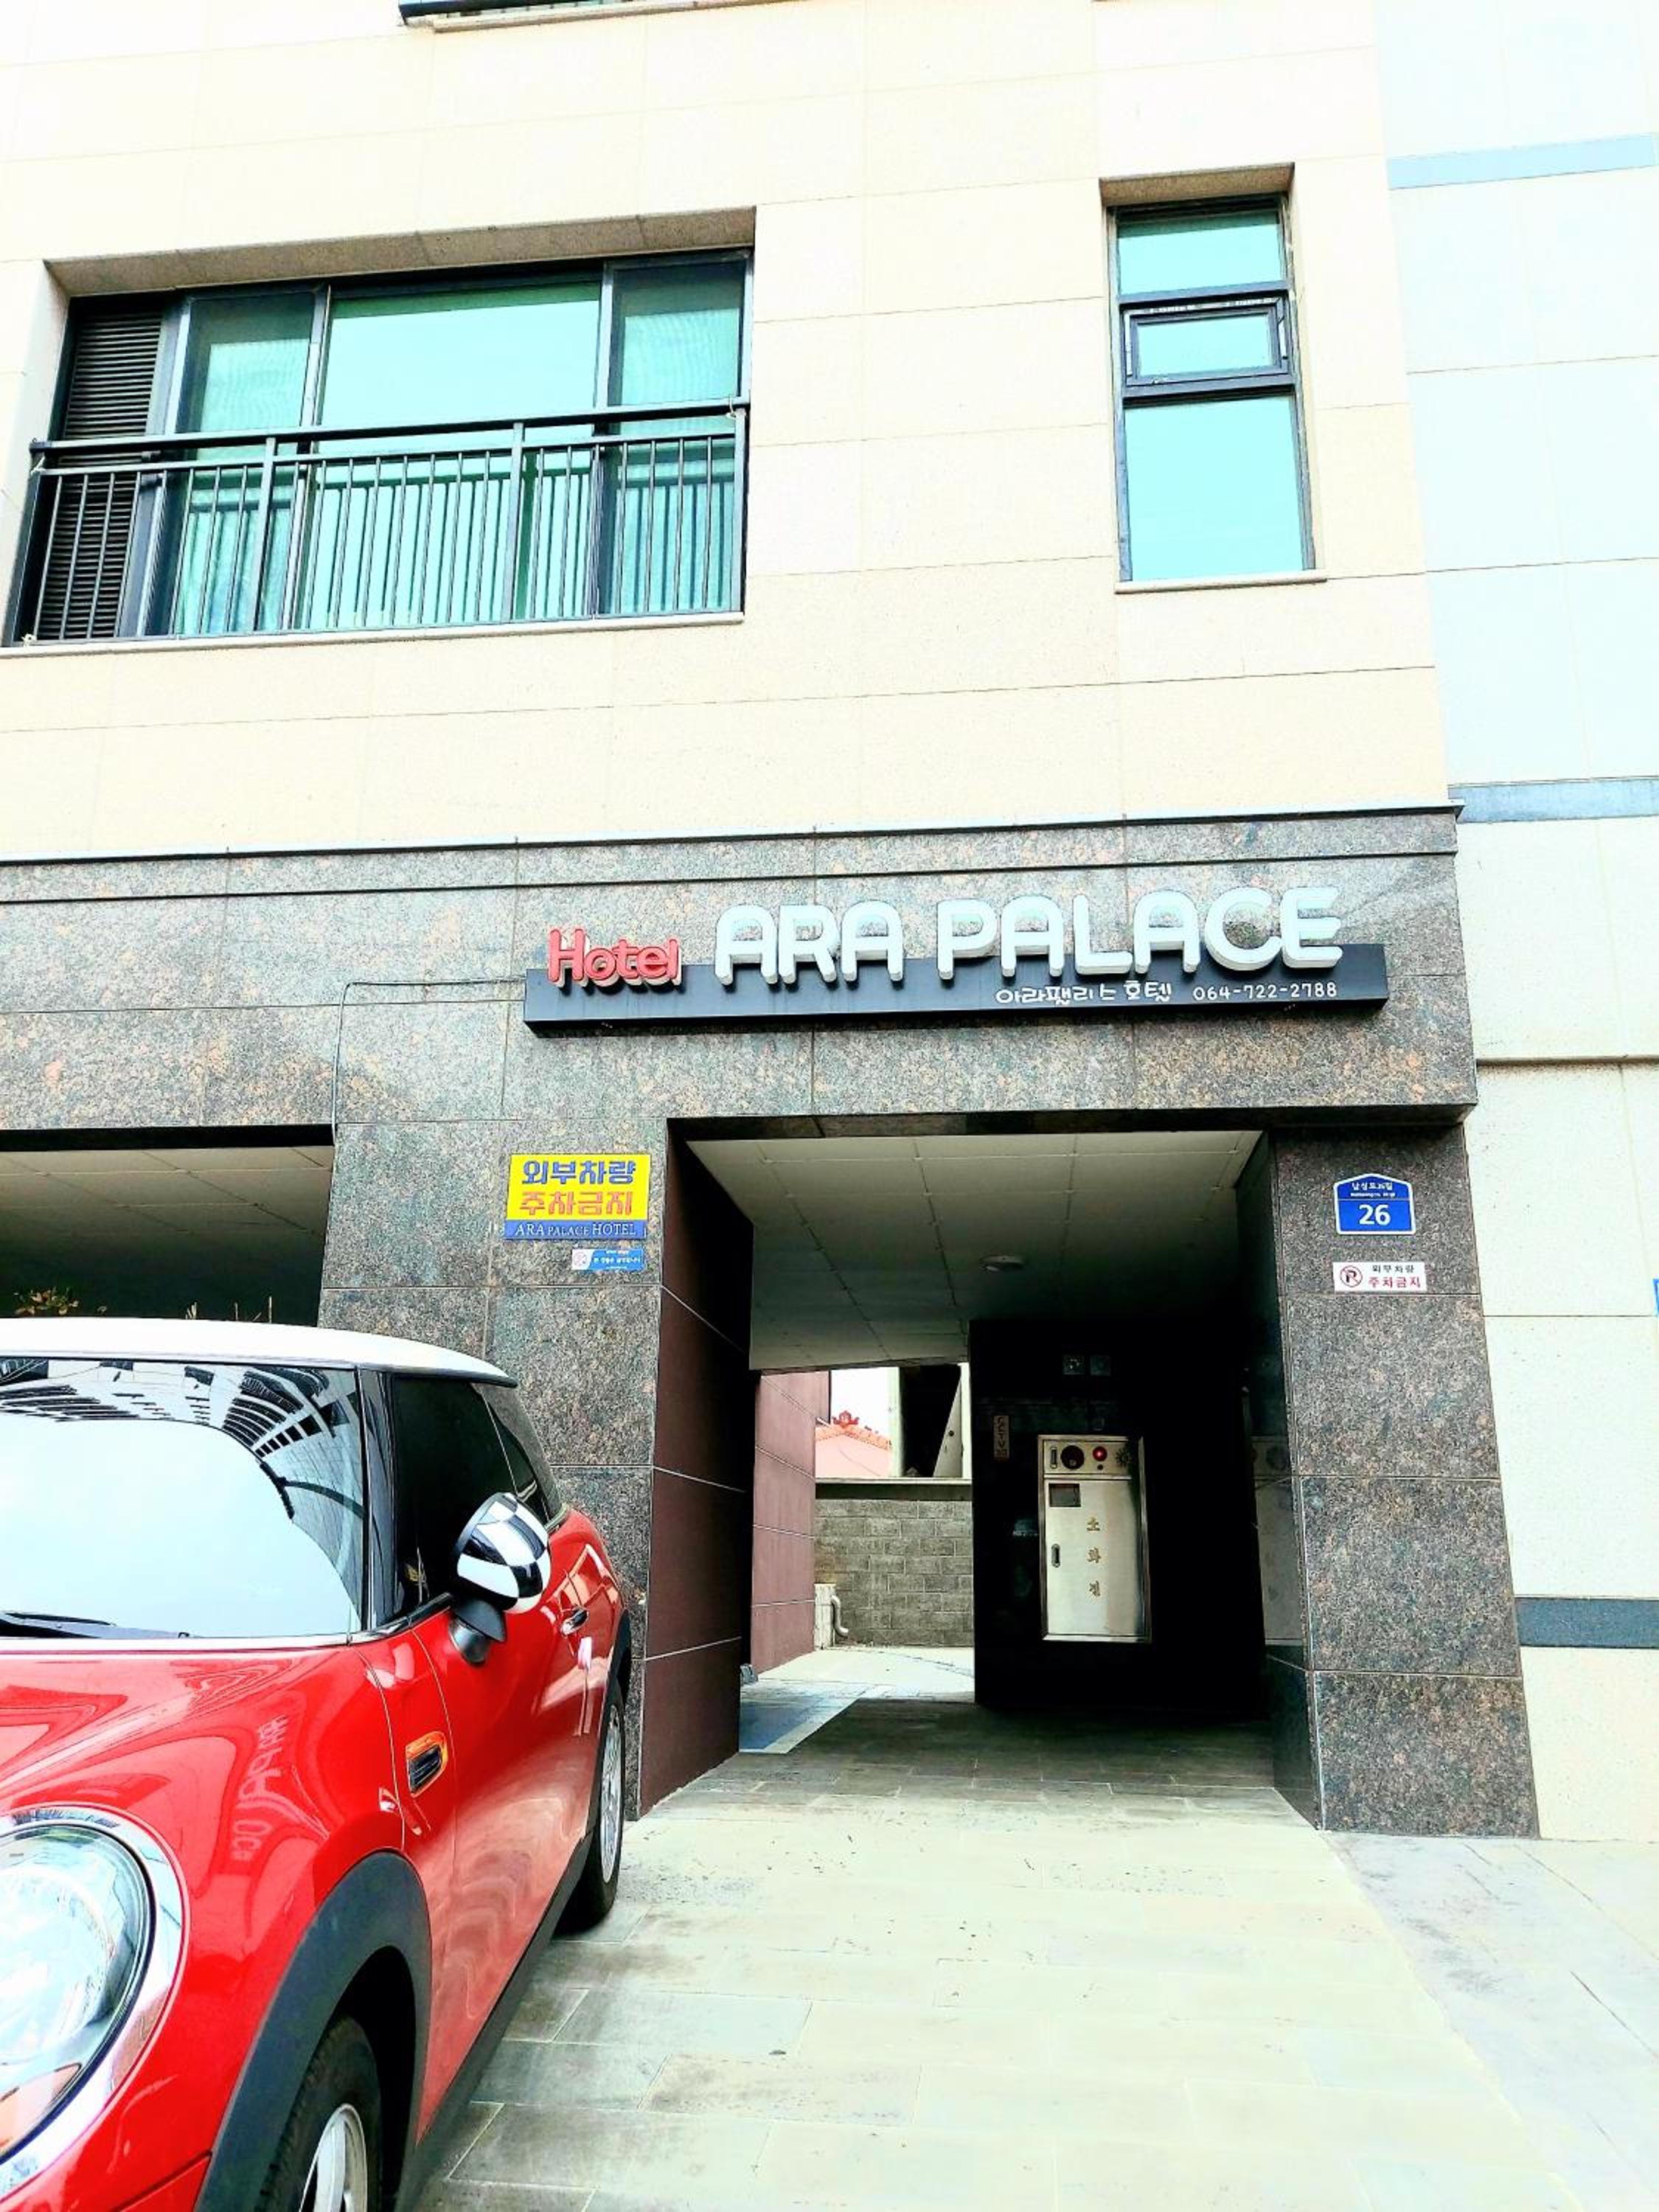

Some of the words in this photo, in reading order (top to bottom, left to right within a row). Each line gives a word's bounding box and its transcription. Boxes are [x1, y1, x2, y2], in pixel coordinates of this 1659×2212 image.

[547, 927, 682, 987] Hotel
[714, 901, 904, 986] ARA
[937, 887, 1343, 981] PALACE
[1124, 980, 1172, 1002] 호텔
[1192, 981, 1338, 1001] 064-722-2788
[521, 1160, 636, 1185] 외부차량
[519, 1190, 633, 1216] 주차금지
[1358, 1204, 1391, 1225] 26
[515, 1222, 545, 1236] ARA
[547, 1225, 590, 1237] PALACE
[591, 1222, 637, 1235] HOTEL
